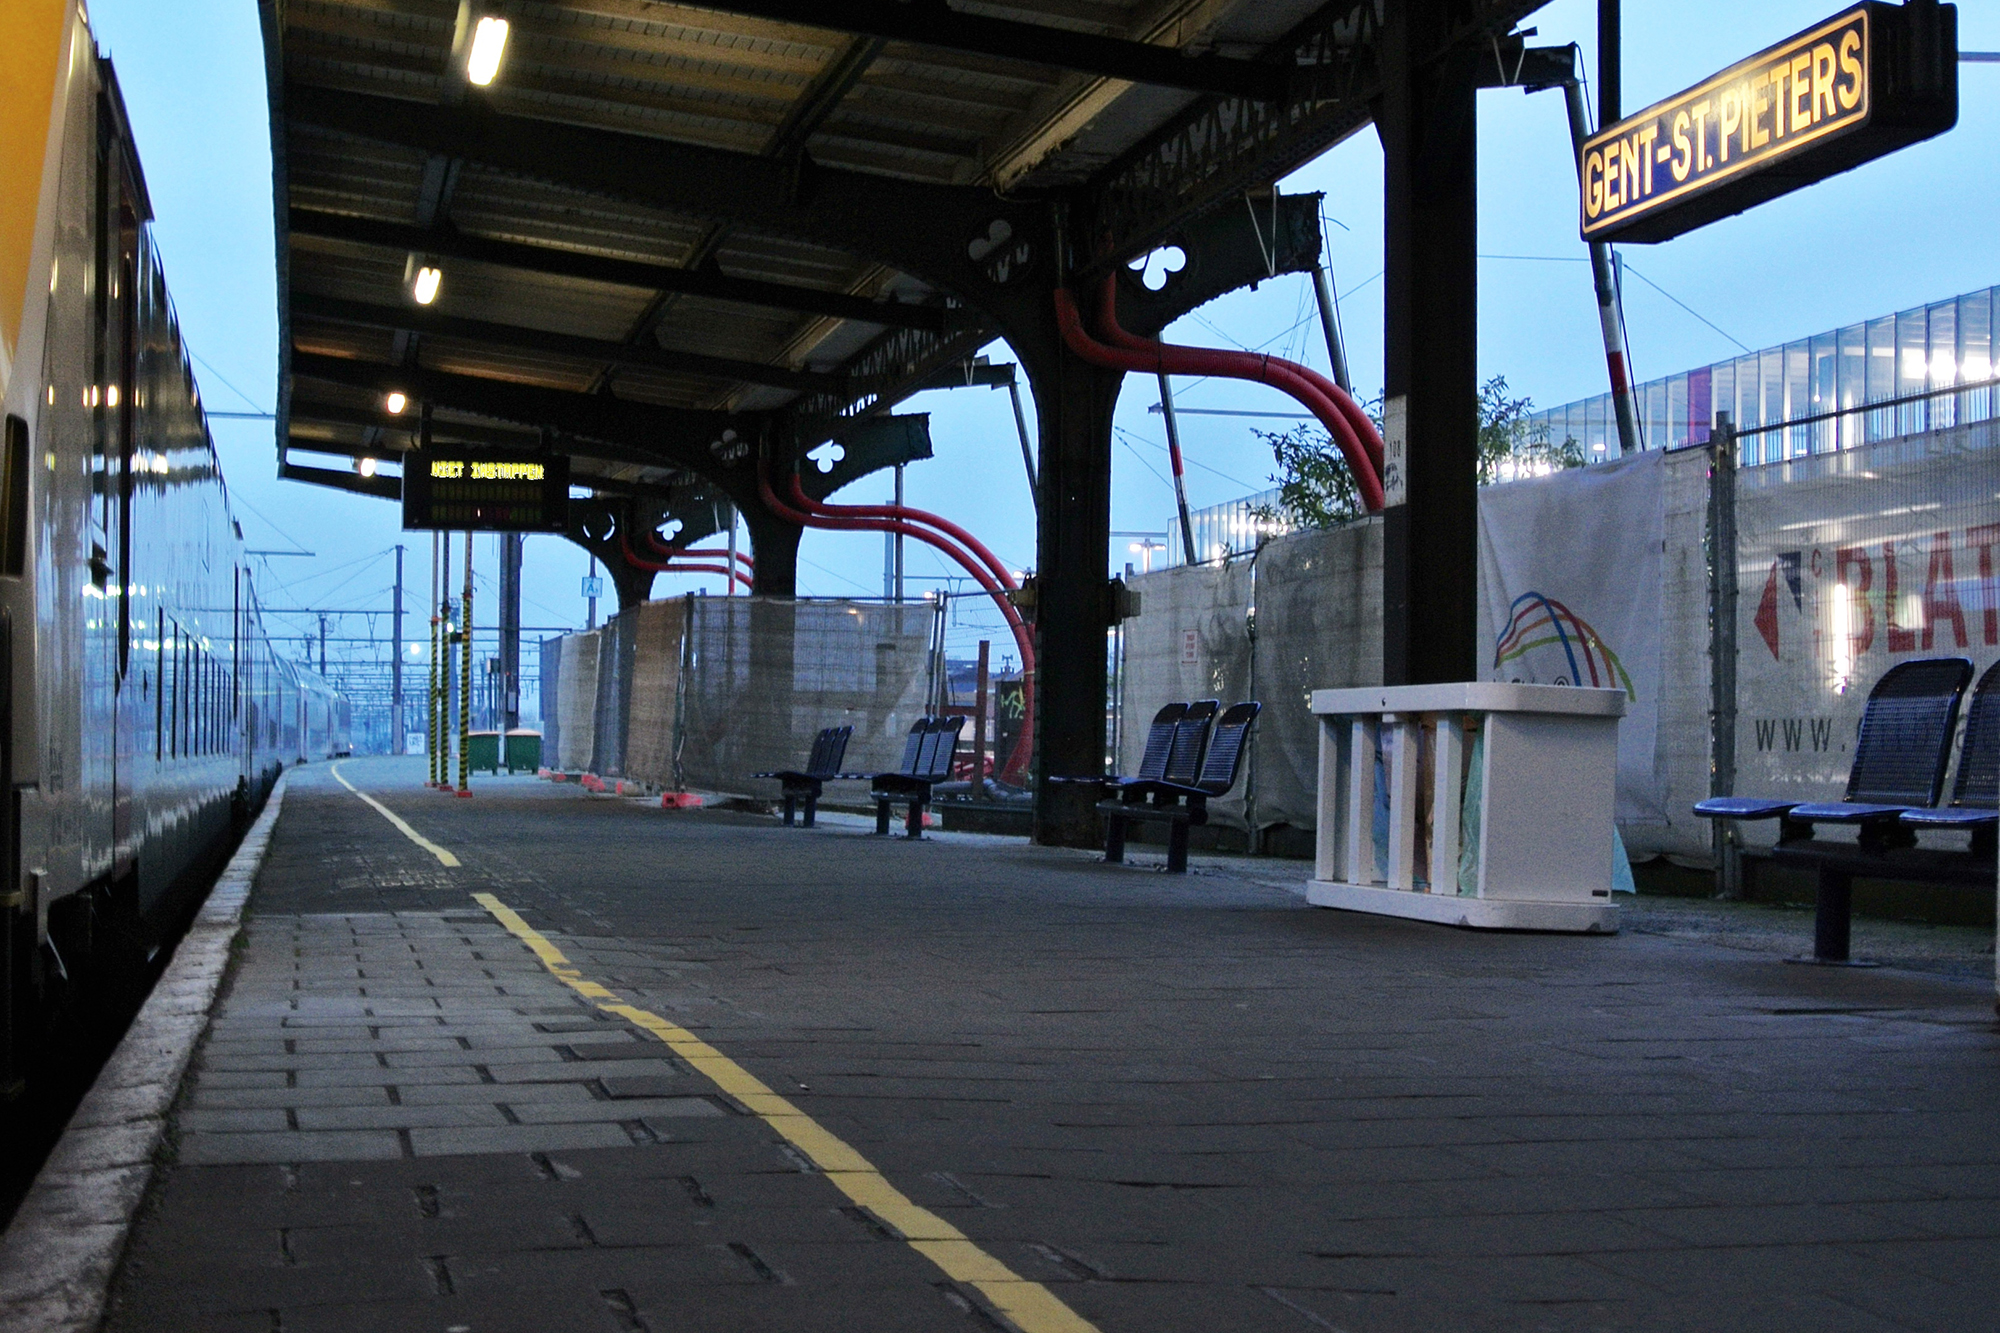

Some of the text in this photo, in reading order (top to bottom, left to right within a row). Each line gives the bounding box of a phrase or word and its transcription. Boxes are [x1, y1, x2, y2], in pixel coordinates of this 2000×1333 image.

[431, 461, 544, 480] NIET INSTAPPEN
[1756, 718, 1863, 752] WWW.
